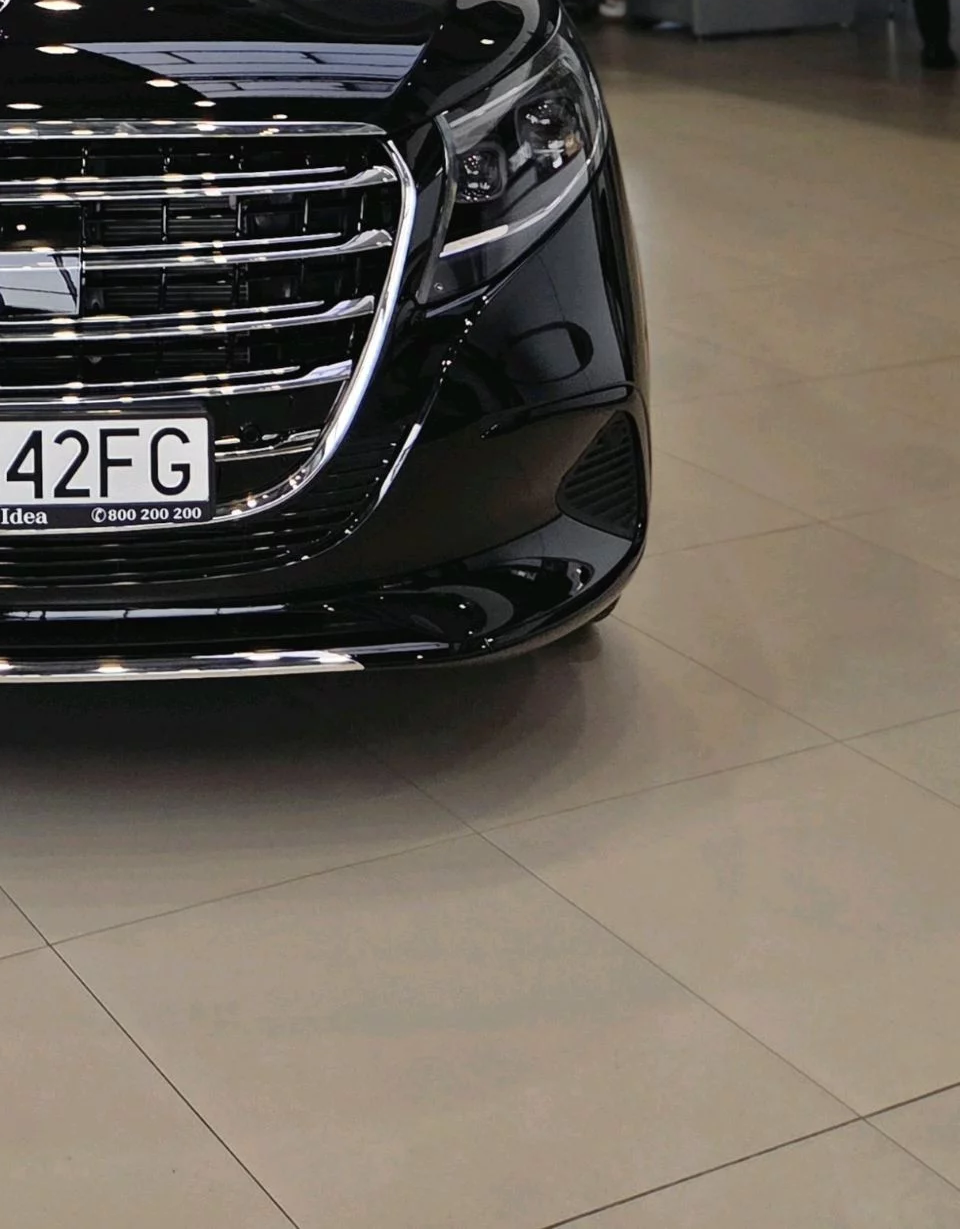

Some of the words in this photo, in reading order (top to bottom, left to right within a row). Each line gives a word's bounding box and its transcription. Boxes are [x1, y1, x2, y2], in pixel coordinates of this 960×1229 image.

[0, 507, 48, 525] Idea
[107, 508, 137, 522] 800
[140, 508, 169, 521] 200
[173, 507, 202, 520] 200
